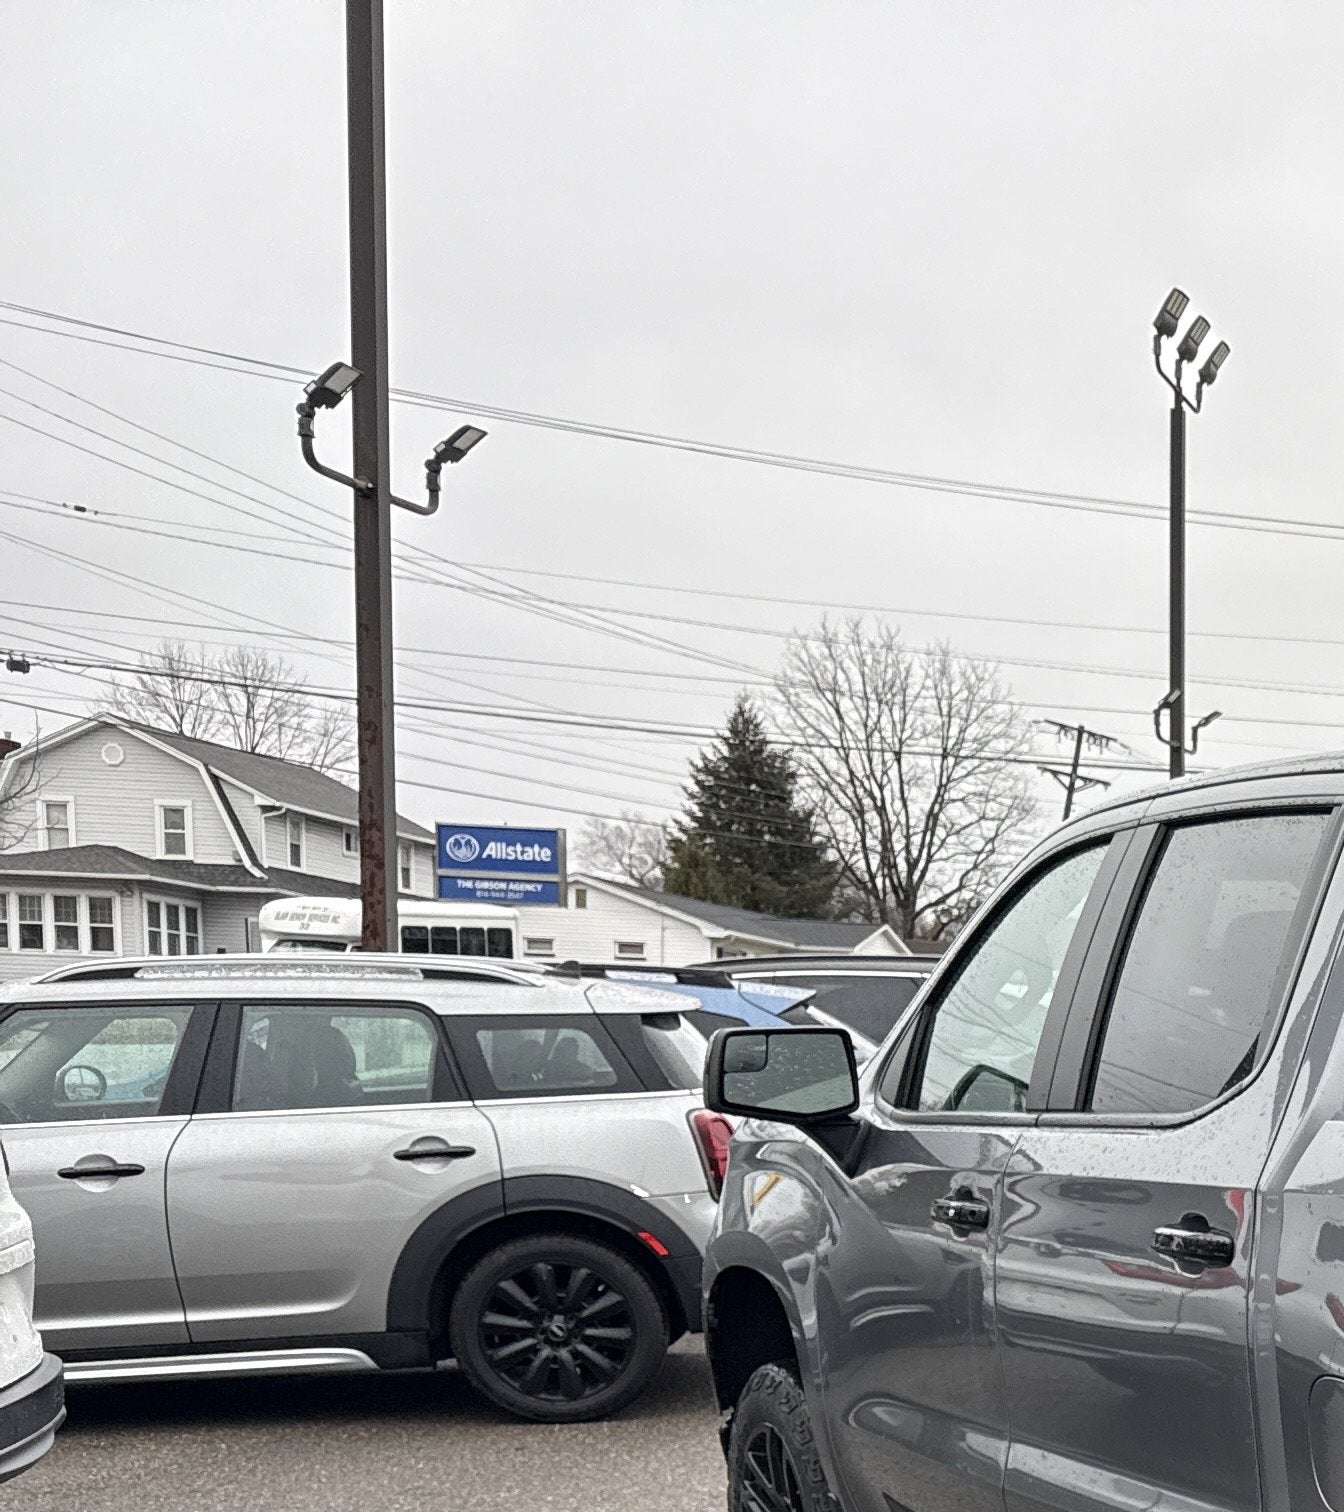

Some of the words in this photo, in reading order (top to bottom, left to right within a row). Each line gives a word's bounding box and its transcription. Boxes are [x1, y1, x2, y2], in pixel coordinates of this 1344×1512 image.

[482, 841, 552, 862] Allstate
[457, 879, 473, 889] THE
[508, 882, 543, 893] AGENCY
